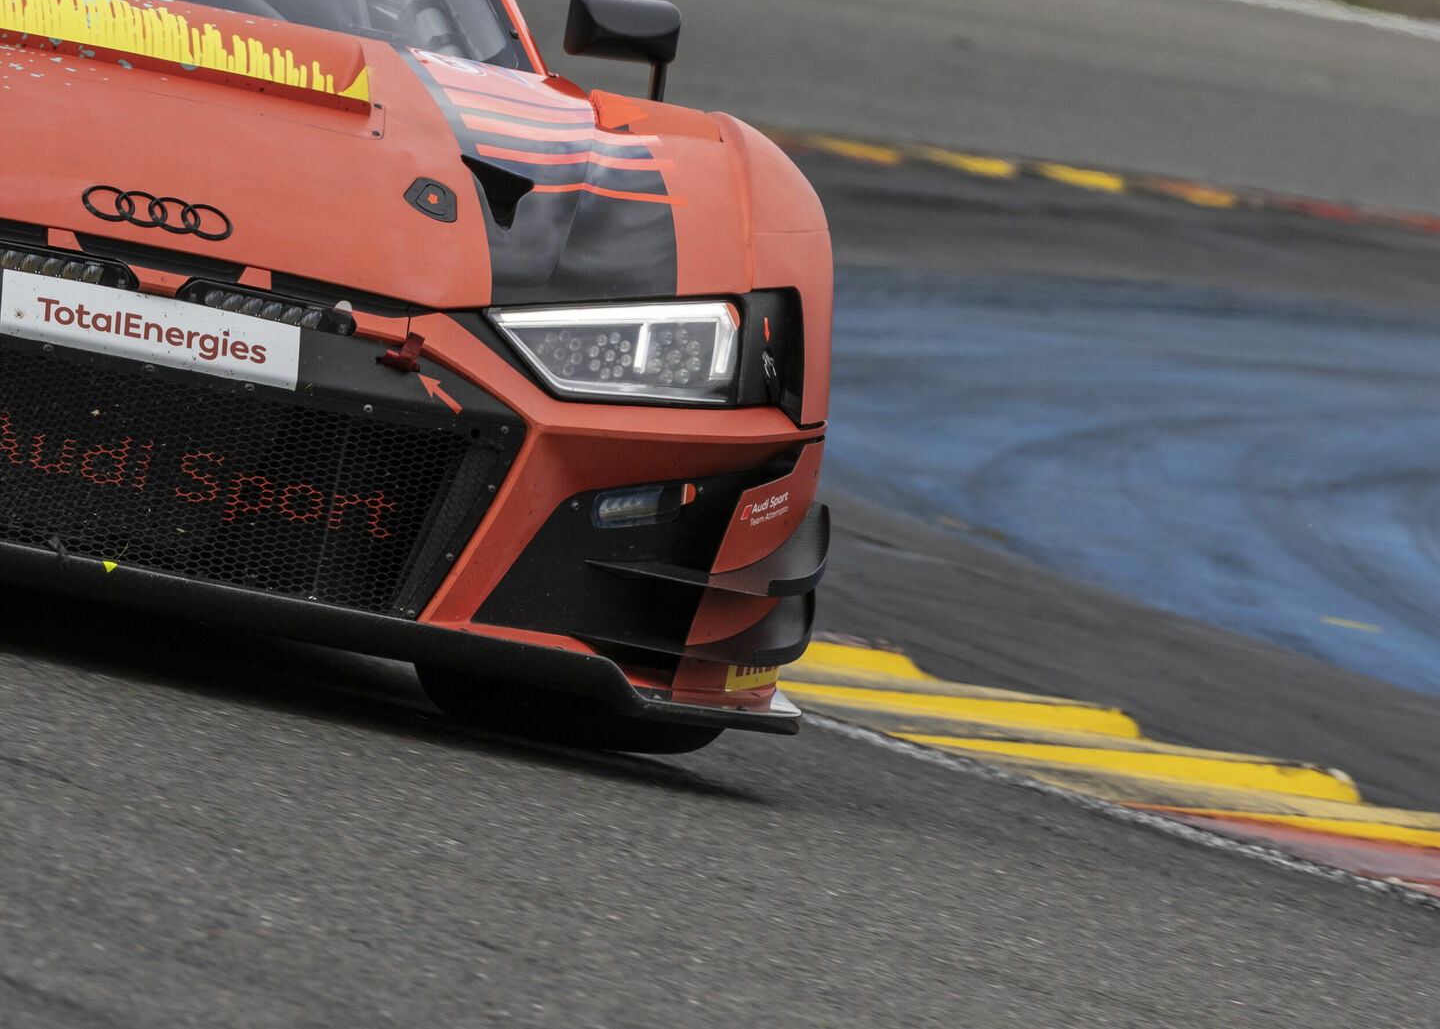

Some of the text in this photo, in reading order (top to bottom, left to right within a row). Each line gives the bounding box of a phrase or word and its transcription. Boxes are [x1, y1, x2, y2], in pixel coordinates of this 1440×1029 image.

[37, 296, 268, 365] TotalEnergies
[174, 450, 399, 539] Sport
[751, 491, 789, 515] Audi Sport
